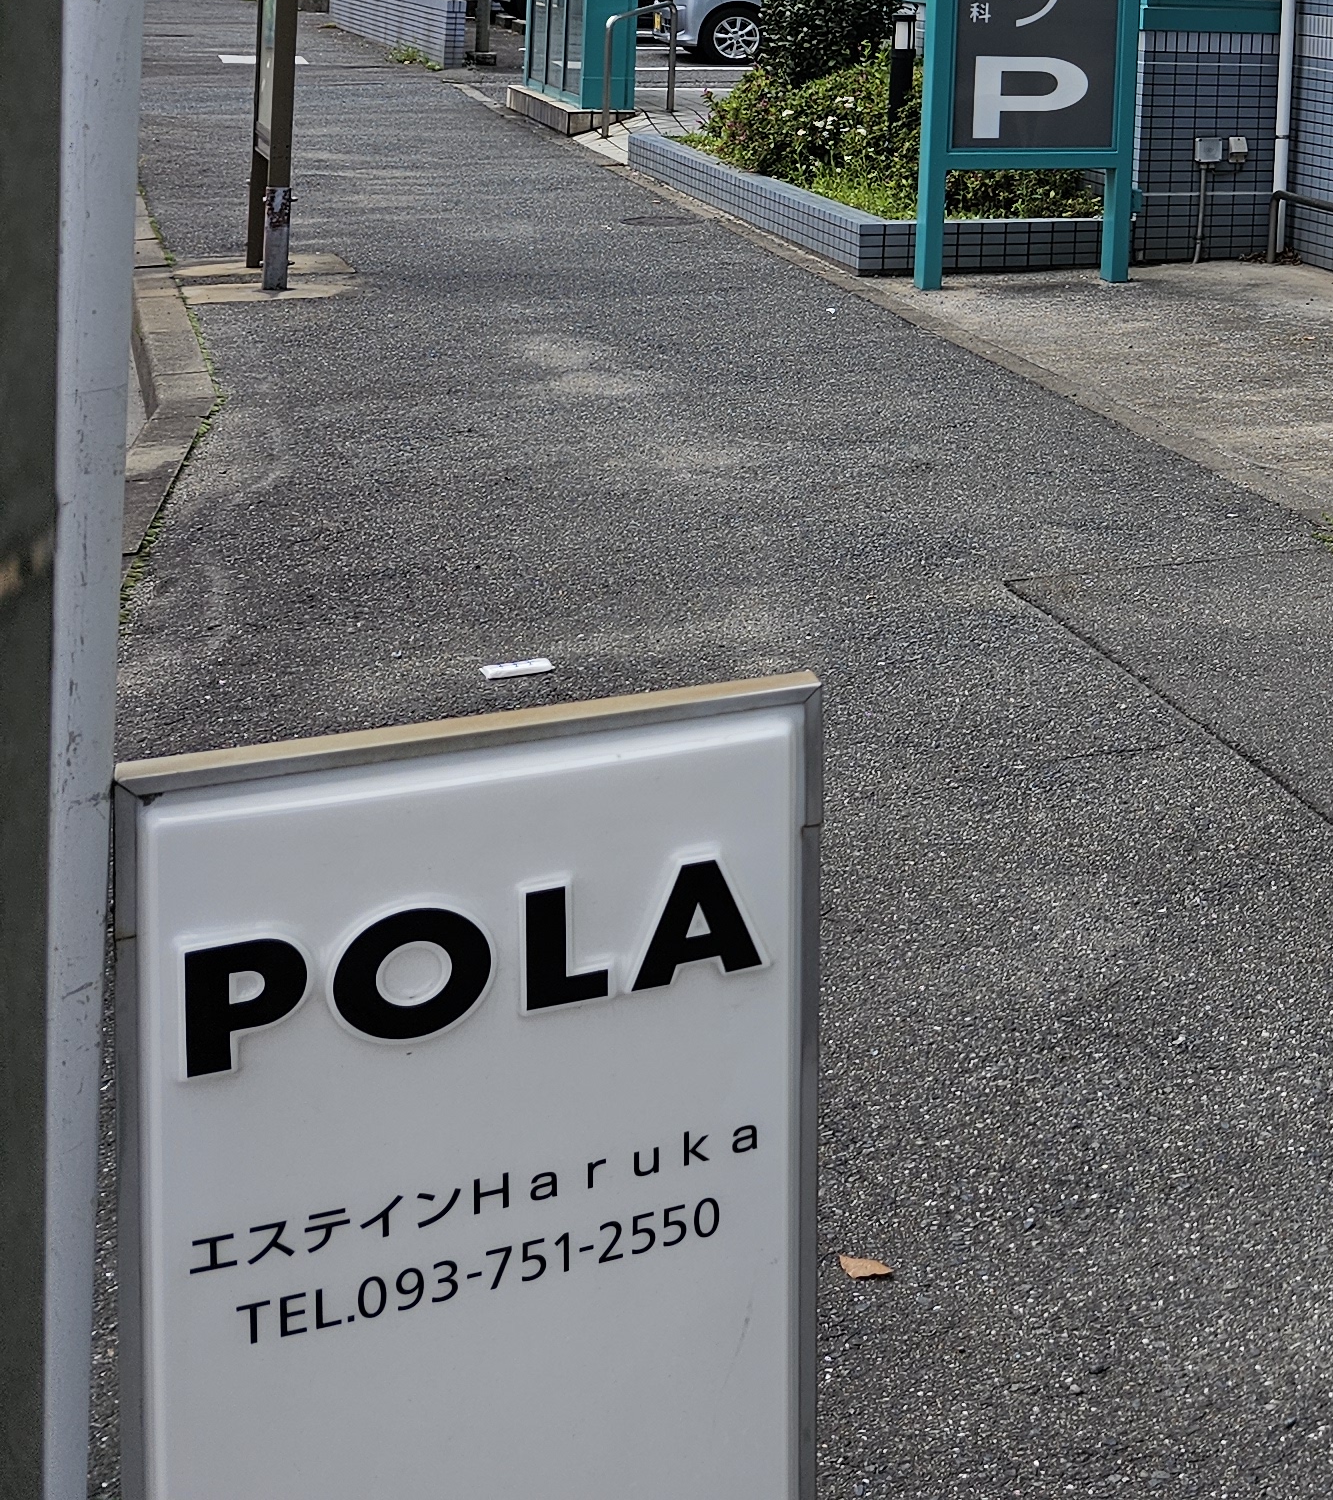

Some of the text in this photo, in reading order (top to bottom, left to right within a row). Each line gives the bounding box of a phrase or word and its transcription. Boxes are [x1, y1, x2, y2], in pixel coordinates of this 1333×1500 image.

[971, 55, 1090, 139] P
[183, 857, 766, 1080] POLA
[235, 1196, 722, 1346] TEL.093-751-2550
